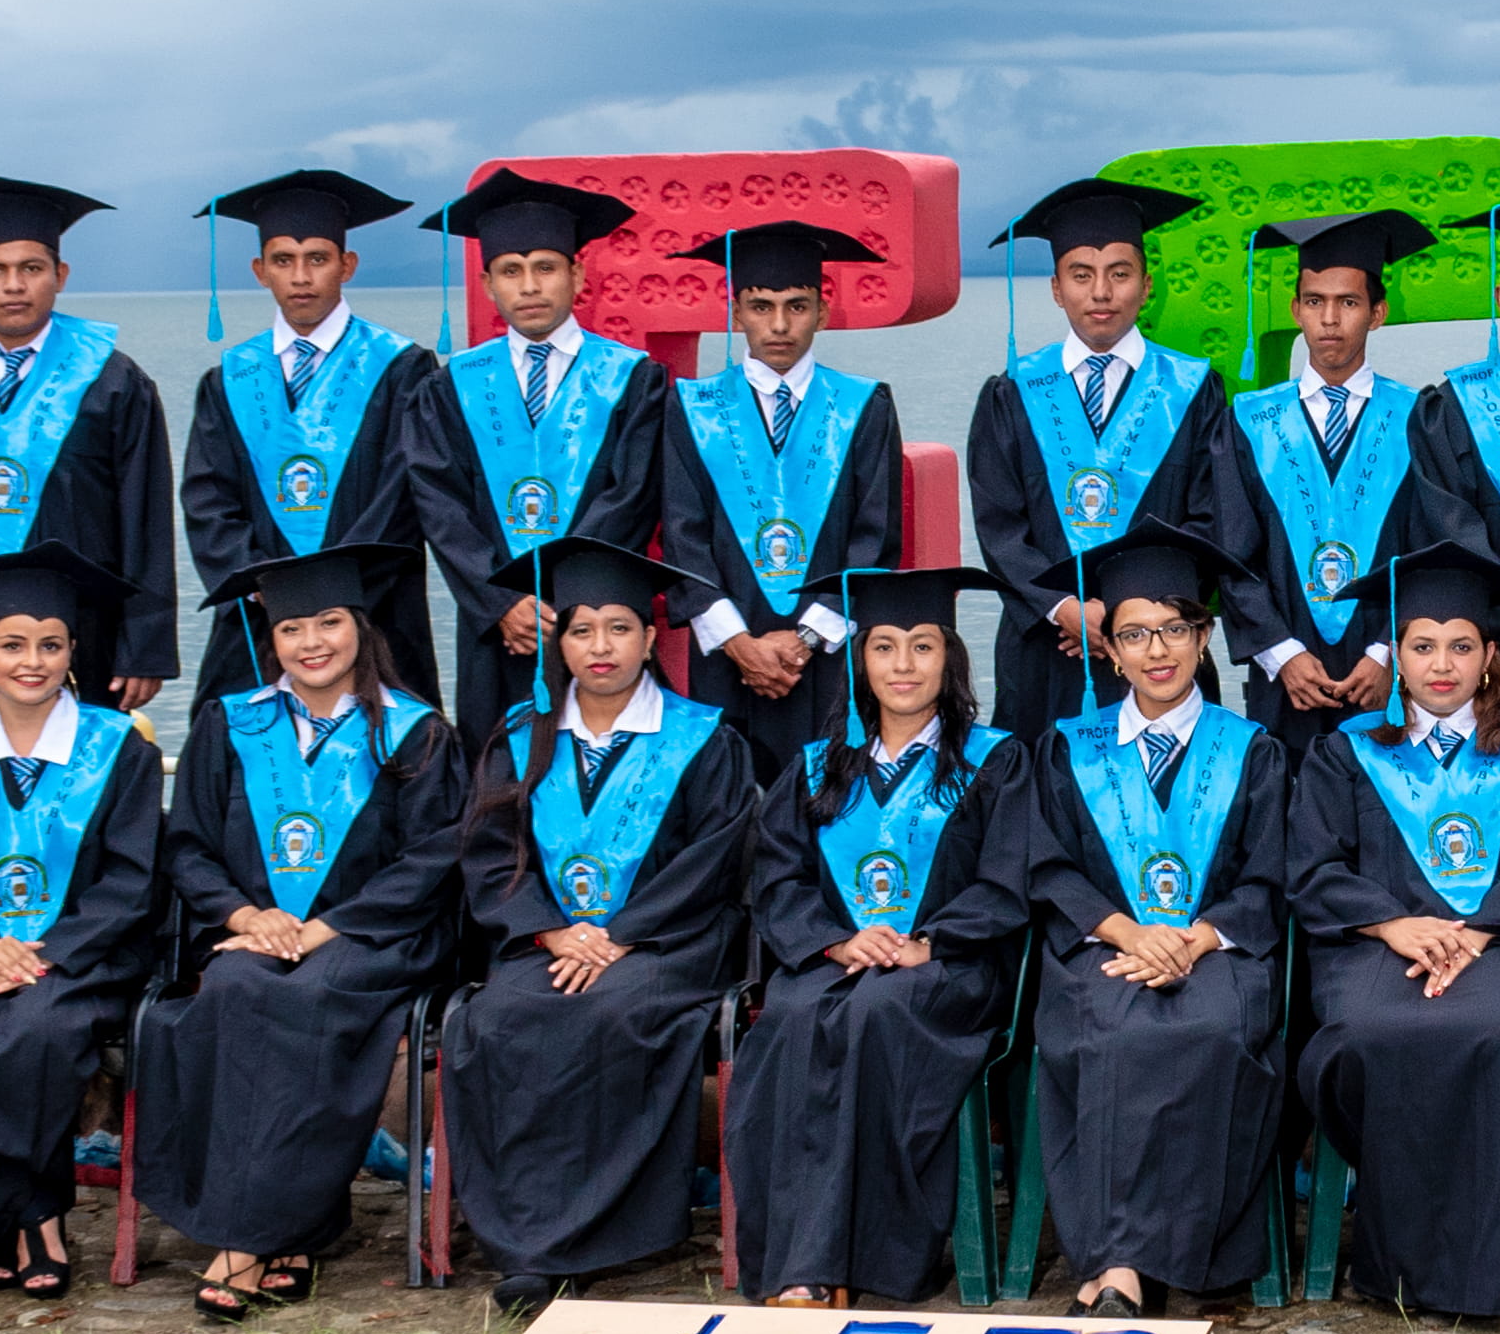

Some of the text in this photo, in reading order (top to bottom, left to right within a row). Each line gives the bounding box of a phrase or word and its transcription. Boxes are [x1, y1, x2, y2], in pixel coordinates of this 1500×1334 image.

[483, 376, 506, 447] JORGE
[803, 388, 840, 485] INFOMBI
[1045, 389, 1076, 473] CARLOS
[1117, 376, 1165, 473] INFOMBI
[1352, 409, 1393, 512] INFOMBI
[1271, 419, 1322, 546] ALEXANDER
[45, 731, 92, 835] INFOMBI
[611, 739, 668, 843] INFOMBI
[1094, 742, 1138, 853] MIREILLY
[1189, 726, 1226, 826] INFOMBI
